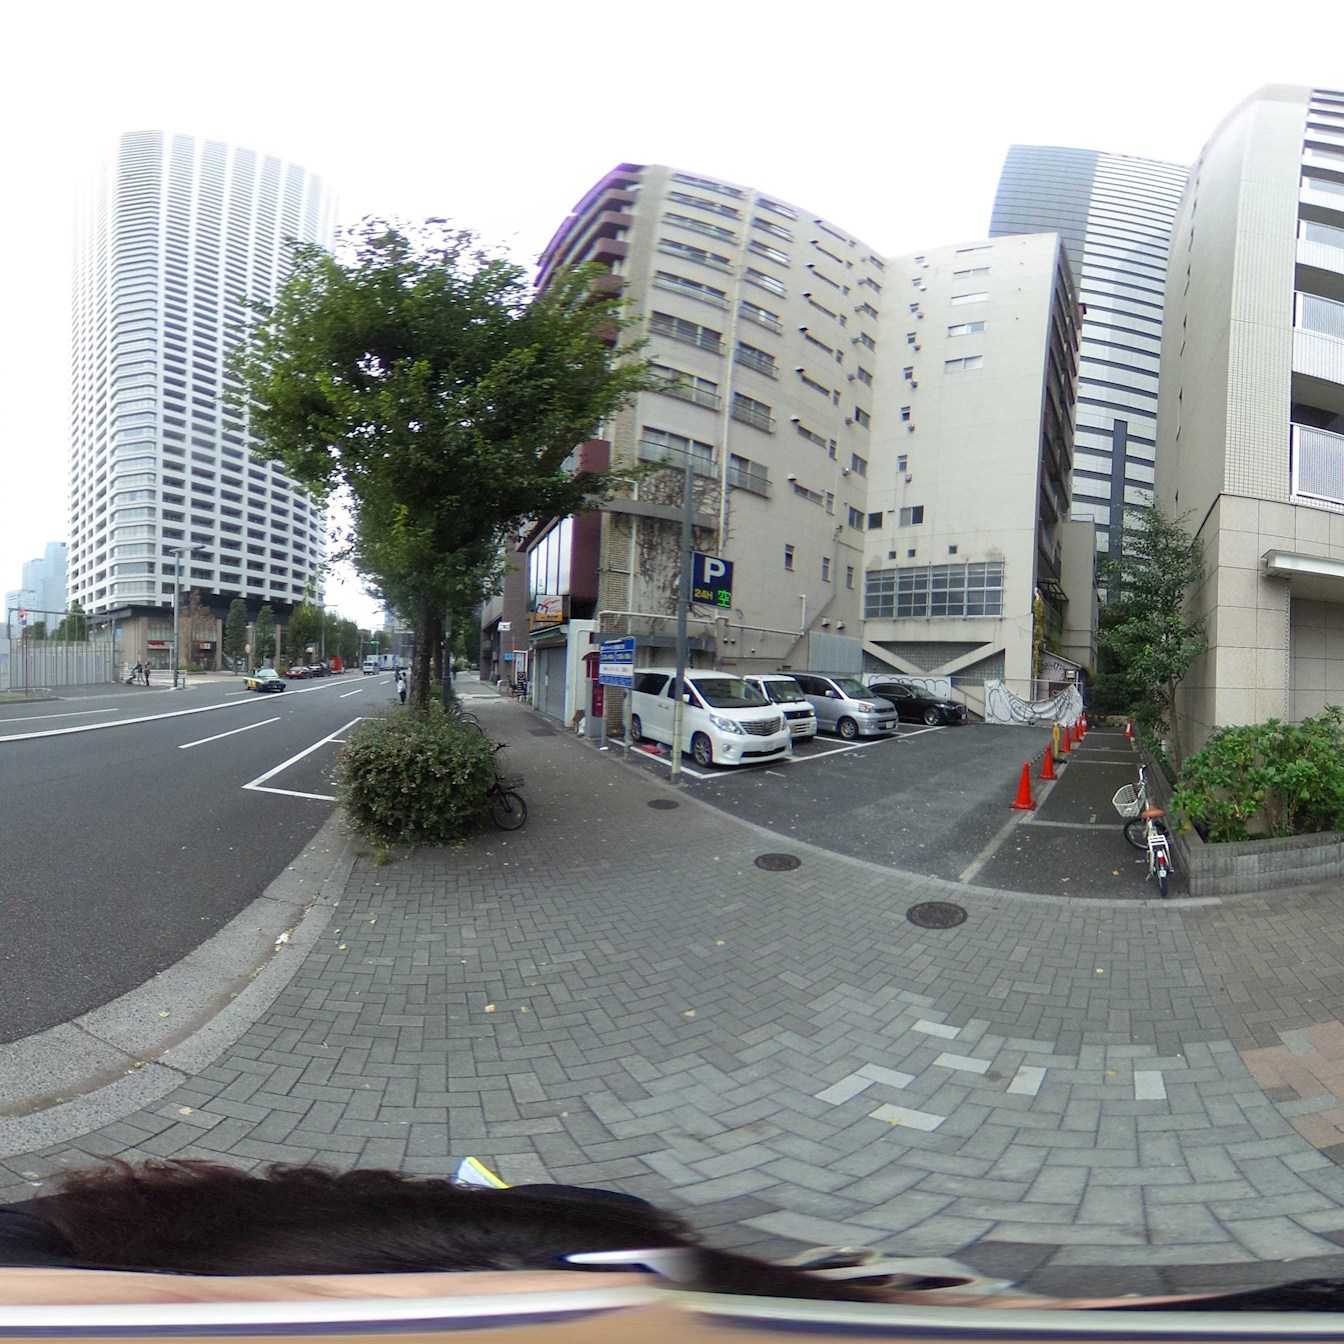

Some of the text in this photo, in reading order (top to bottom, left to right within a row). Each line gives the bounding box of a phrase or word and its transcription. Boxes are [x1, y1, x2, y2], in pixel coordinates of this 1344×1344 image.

[704, 556, 726, 584] P
[694, 588, 714, 601] 24H
[717, 590, 731, 608] 空
